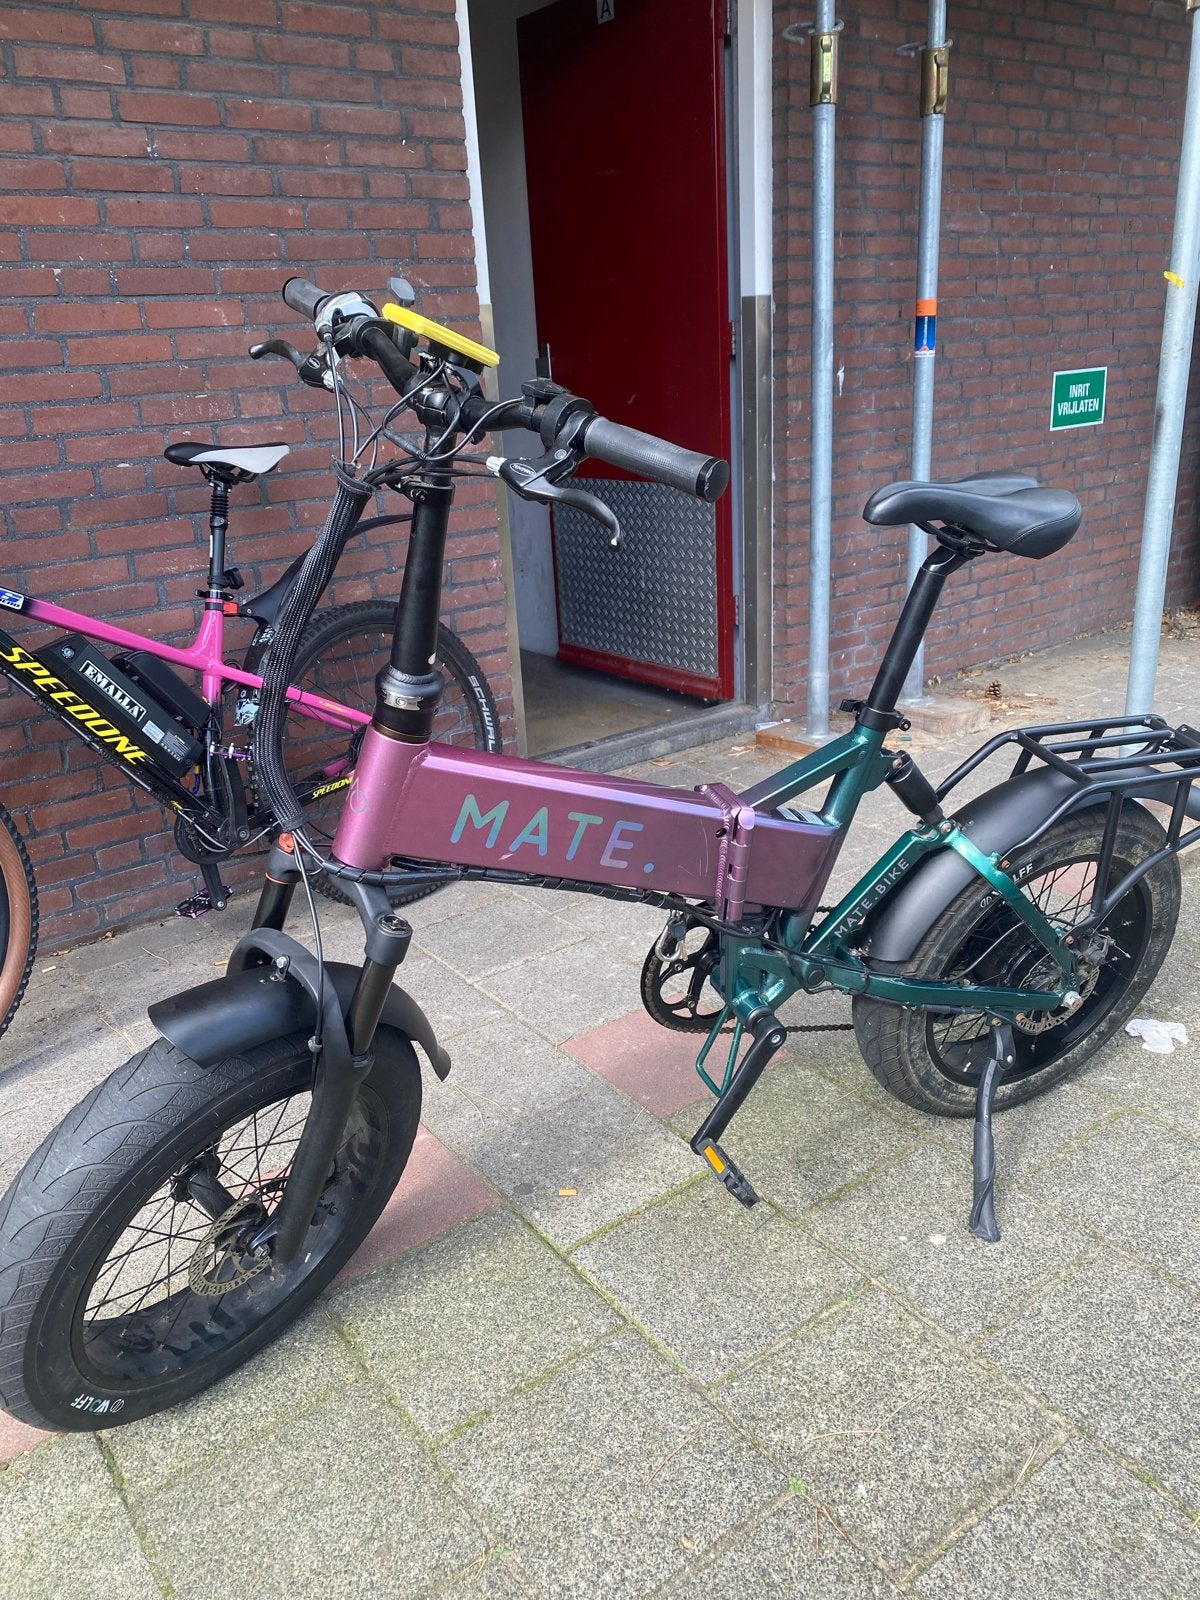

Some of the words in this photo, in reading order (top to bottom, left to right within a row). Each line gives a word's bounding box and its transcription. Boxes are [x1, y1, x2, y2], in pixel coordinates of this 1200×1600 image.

[1057, 398, 1100, 416] VRIJLATEN
[1069, 383, 1091, 399] INRIT
[0, 647, 154, 766] SPEEDONE
[83, 664, 144, 719] EMALLA
[468, 675, 496, 753] SCHWAL
[311, 776, 353, 800] SPEEDON
[450, 794, 655, 874] MATE.
[834, 858, 910, 939] MATE.BIKE
